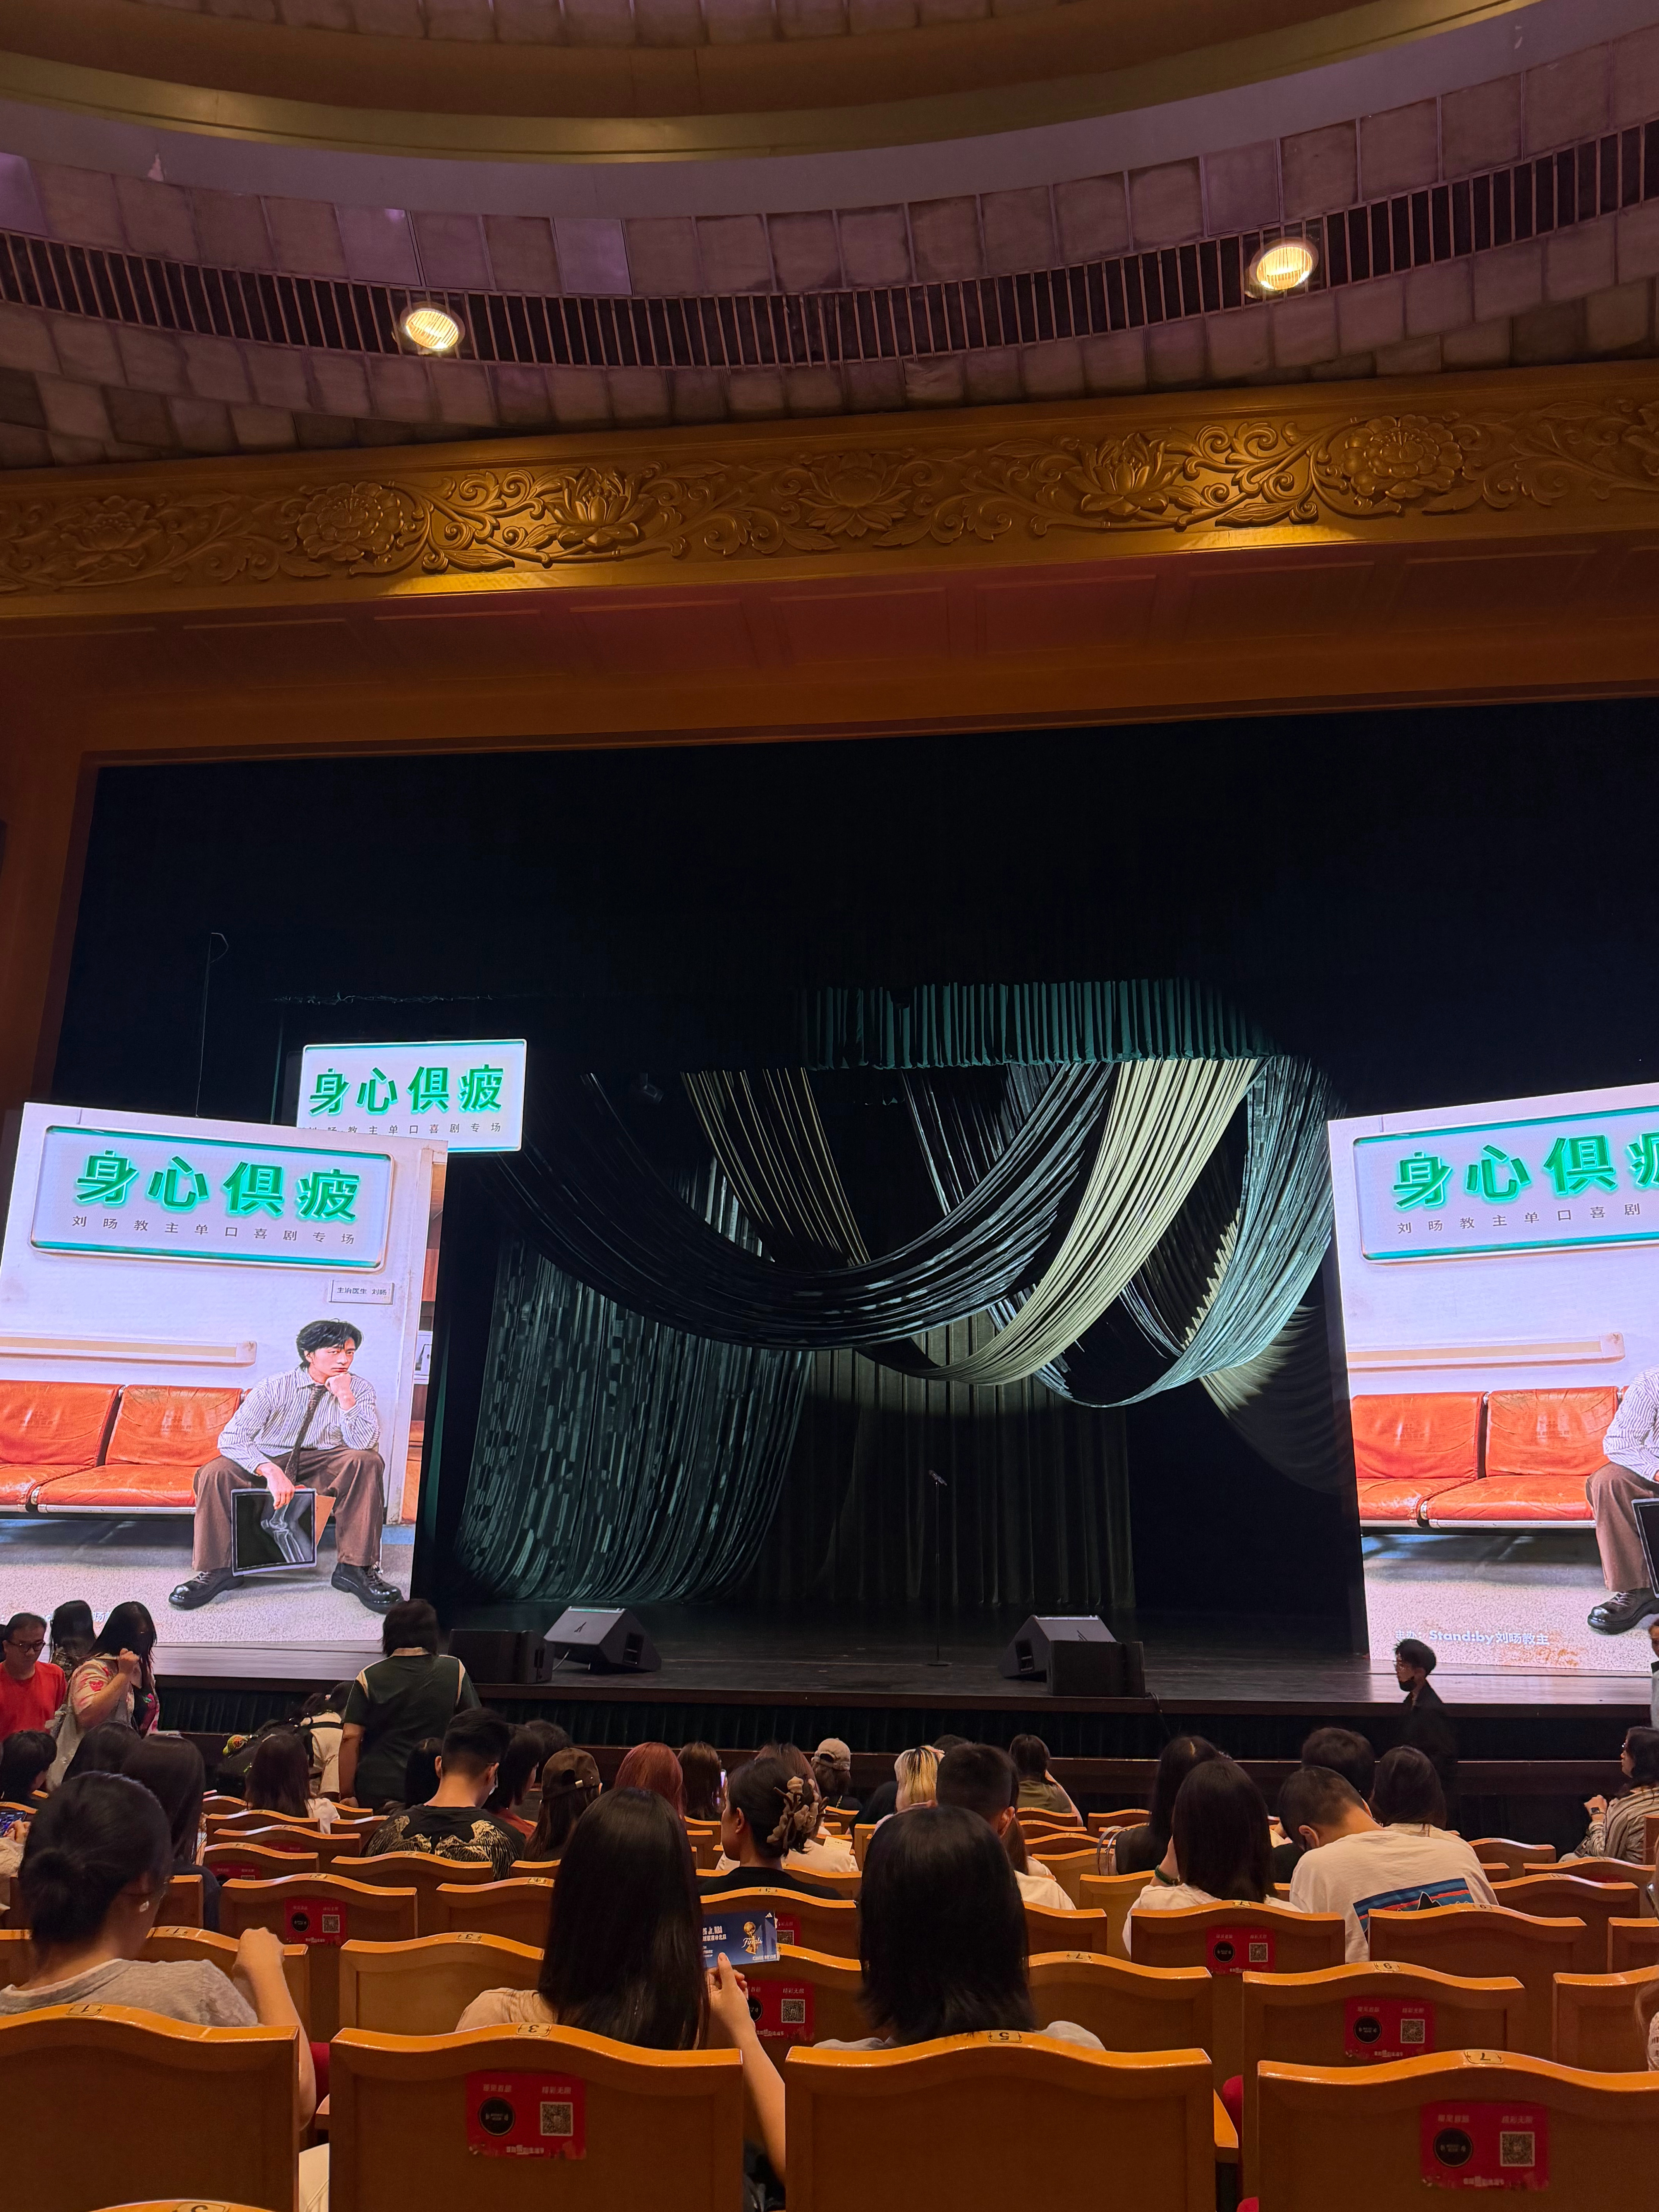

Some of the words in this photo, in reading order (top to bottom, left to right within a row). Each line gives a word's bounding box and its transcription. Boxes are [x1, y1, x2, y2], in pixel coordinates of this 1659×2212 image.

[310, 1064, 503, 1114] 身心俱疲
[77, 1149, 359, 1220] 身心俱疲
[72, 1215, 355, 1245] 刘旸教主单口喜剧专场
[1429, 1630, 1495, 1645] Stand:by
[529, 2025, 539, 2033] 3
[999, 2032, 1010, 2040] 5
[1480, 2052, 1491, 2061] 7
